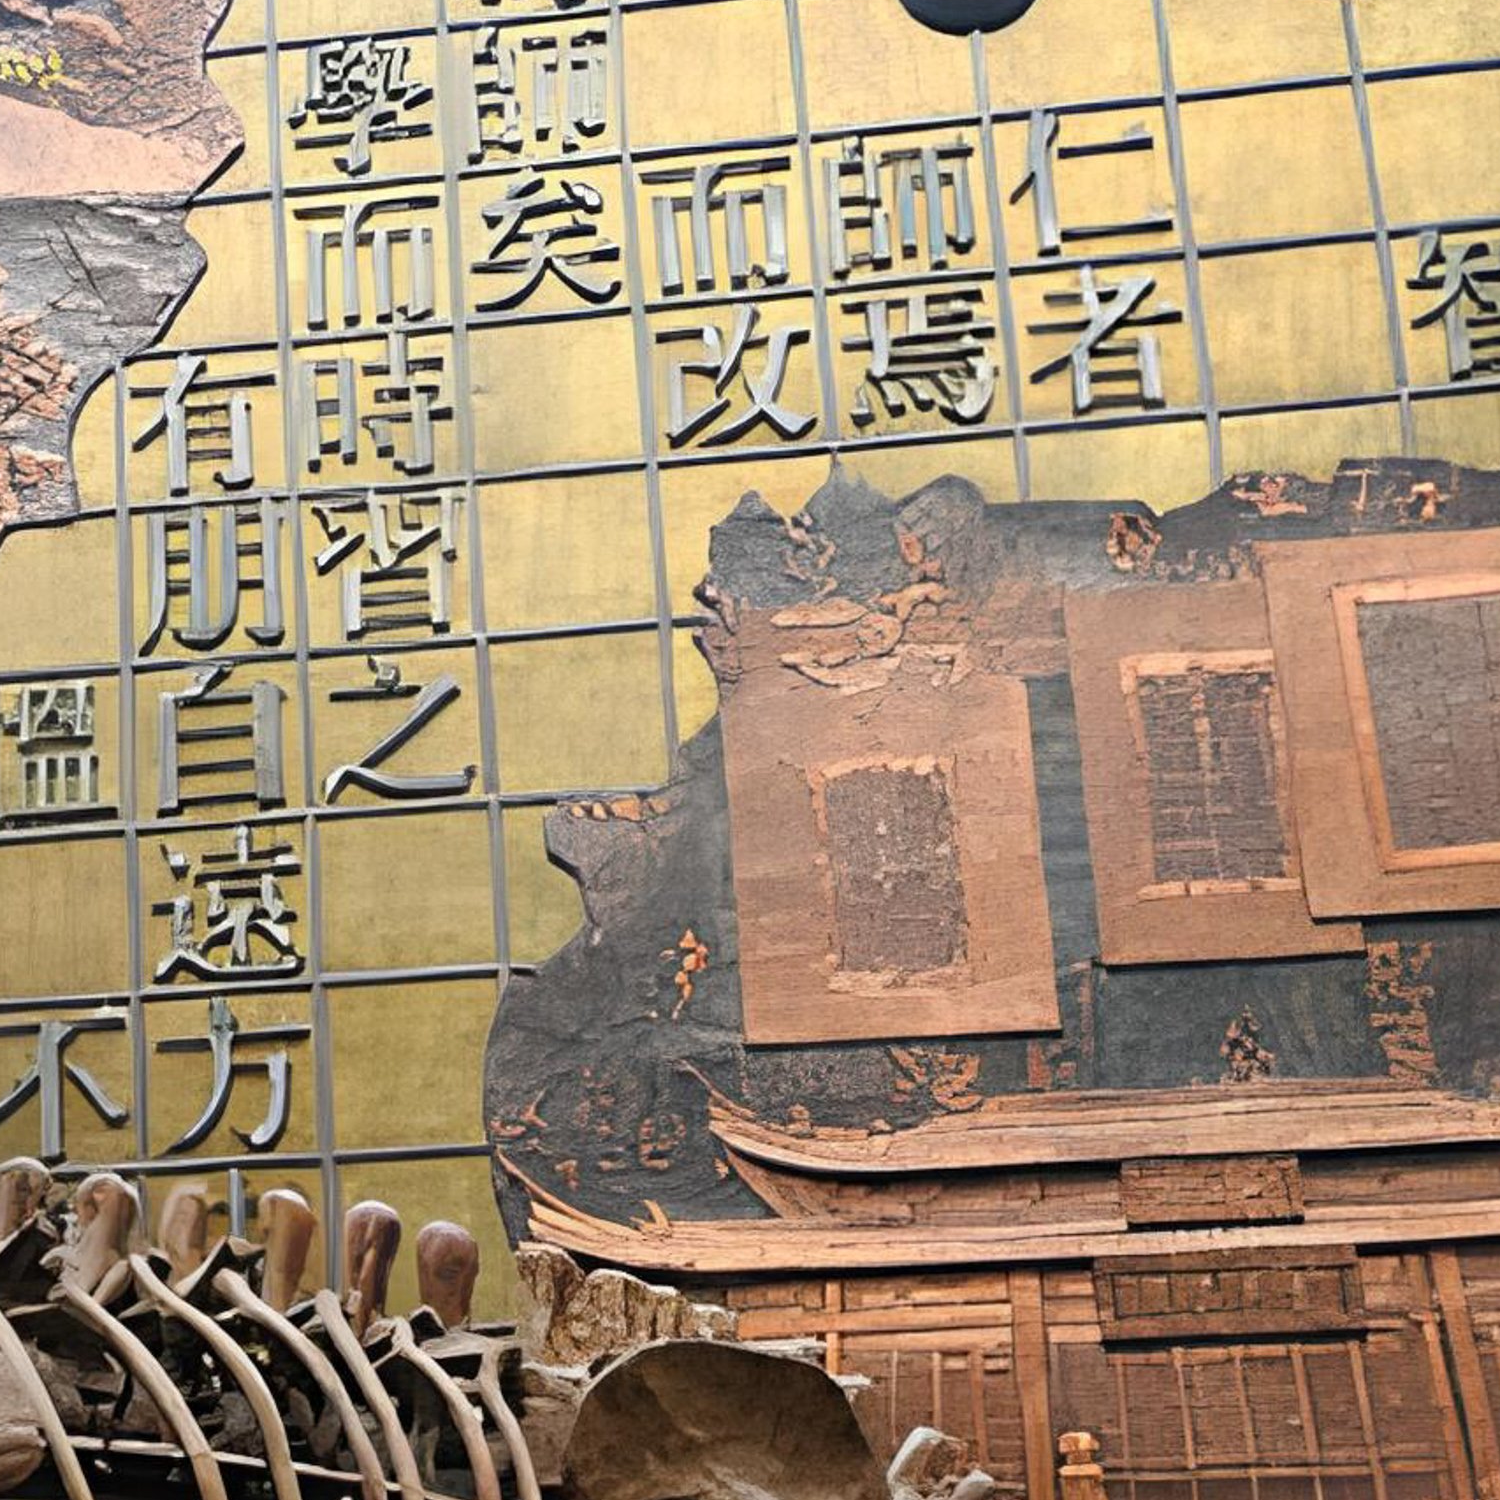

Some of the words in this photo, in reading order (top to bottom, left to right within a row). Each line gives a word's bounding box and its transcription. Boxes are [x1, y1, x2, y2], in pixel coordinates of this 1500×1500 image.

[287, 36, 479, 805] 學而時習之
[635, 155, 818, 450] 而改
[1010, 108, 1183, 417] 仁者
[129, 353, 312, 1156] 有朋自遠方
